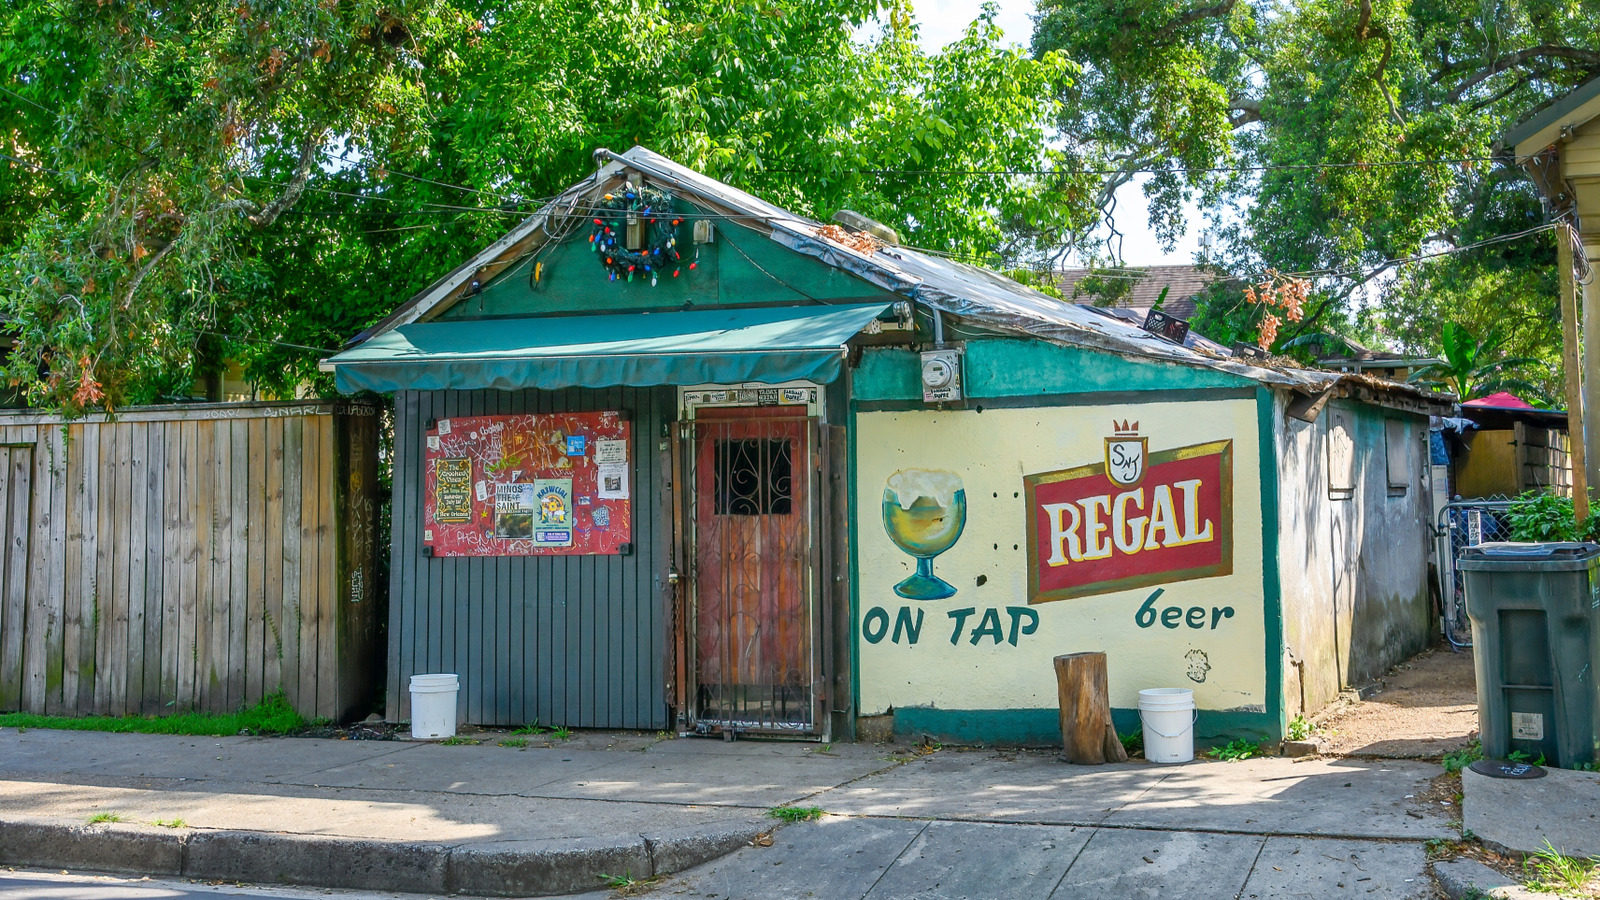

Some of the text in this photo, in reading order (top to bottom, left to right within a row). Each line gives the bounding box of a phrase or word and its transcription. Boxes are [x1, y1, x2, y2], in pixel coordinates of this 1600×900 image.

[496, 484, 523, 493] MINOS
[496, 494, 512, 502] THE
[496, 502, 520, 510] SAINT
[1042, 479, 1214, 566] REGAL
[1135, 587, 1235, 630] beer
[862, 605, 1040, 648] ON TAP
